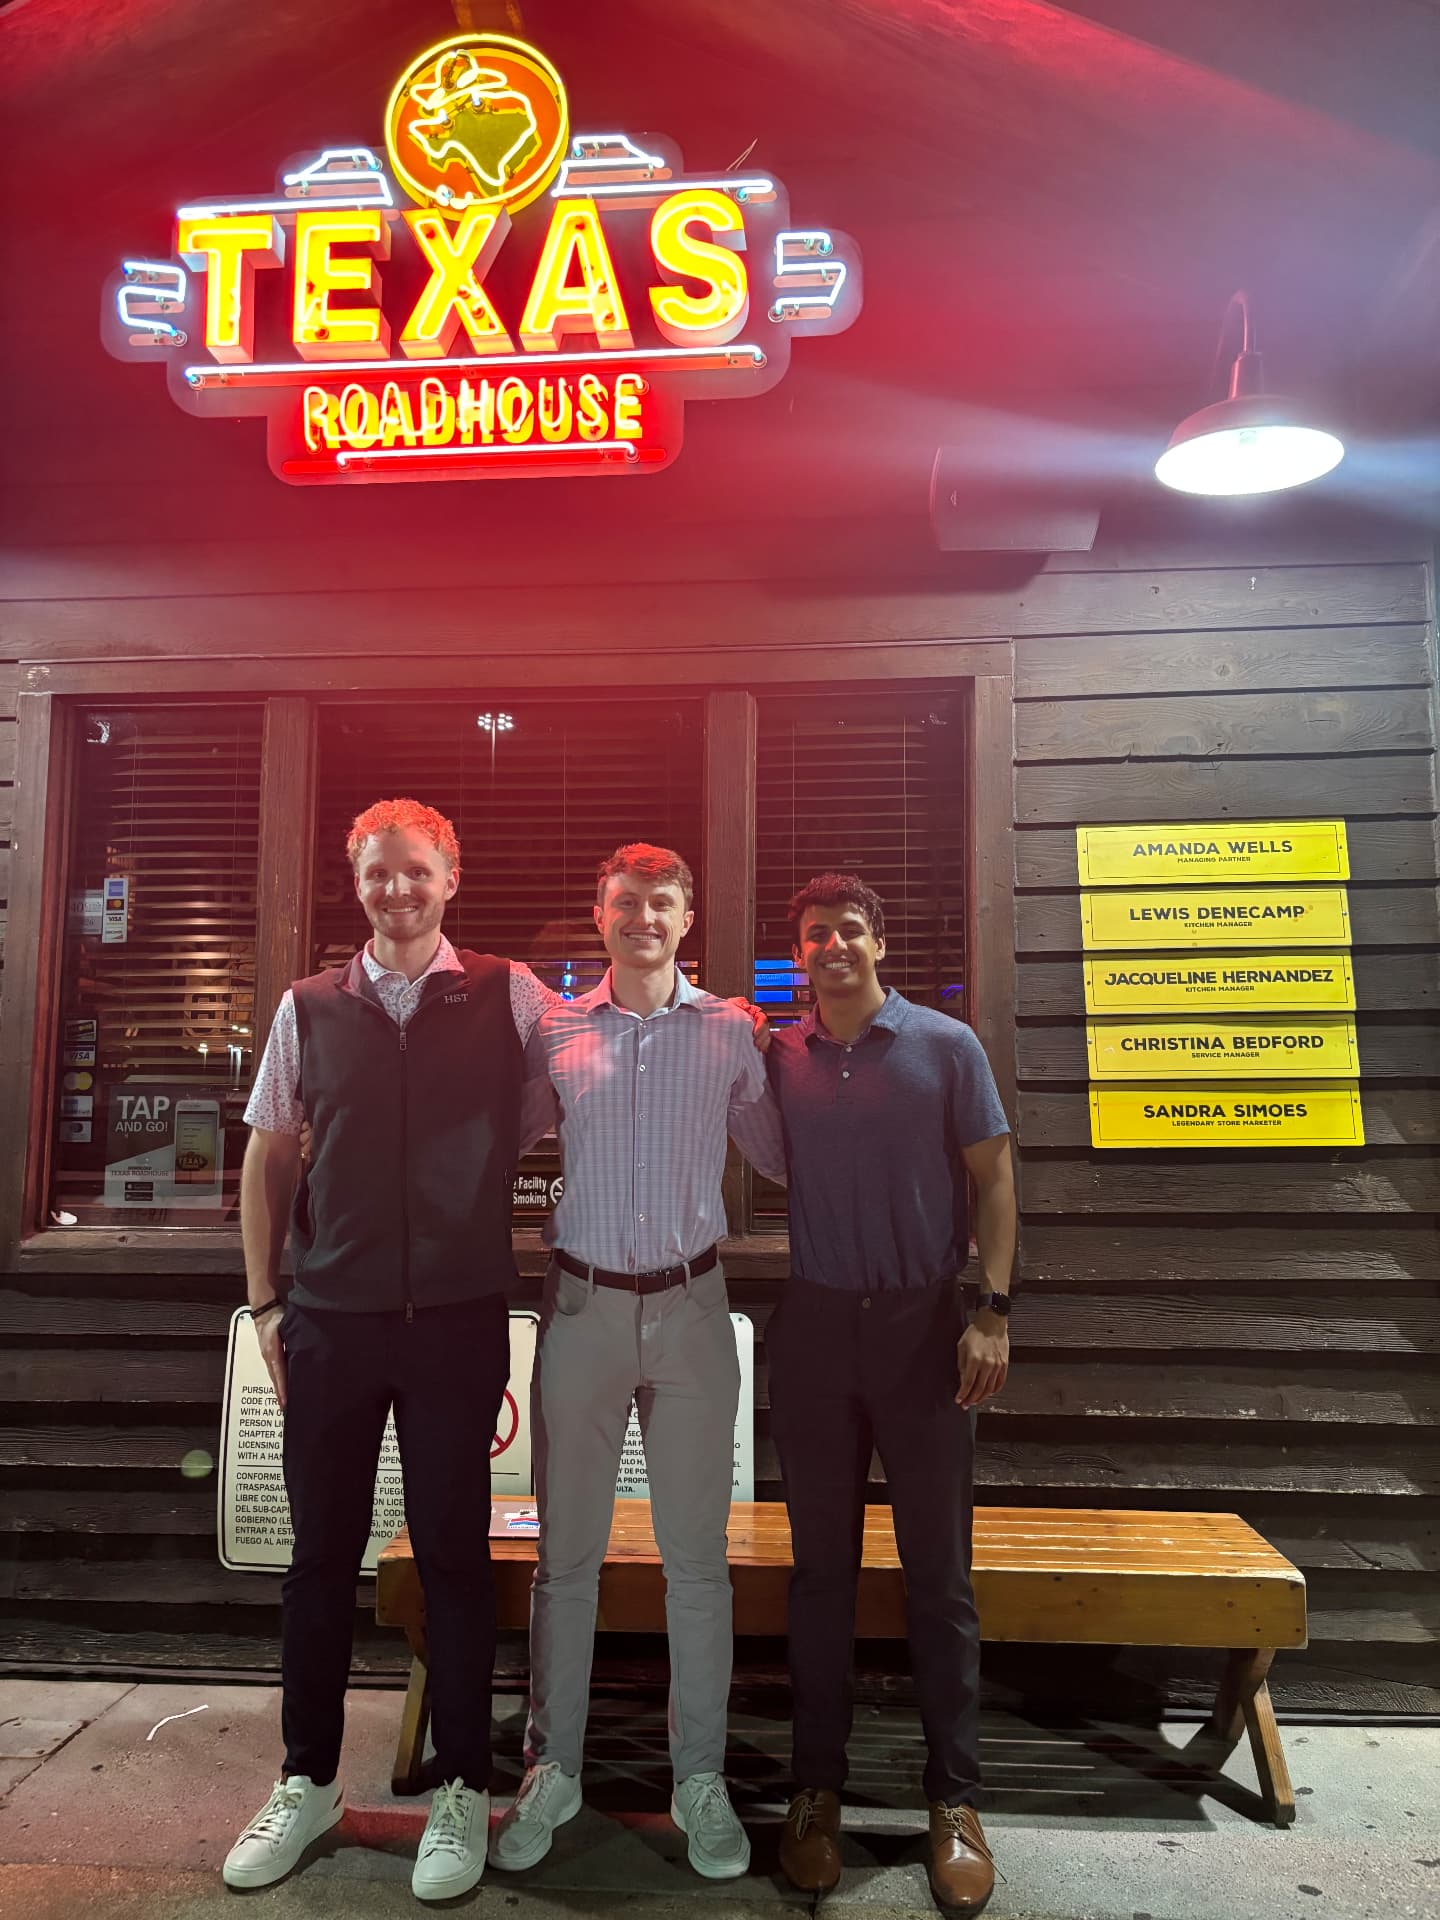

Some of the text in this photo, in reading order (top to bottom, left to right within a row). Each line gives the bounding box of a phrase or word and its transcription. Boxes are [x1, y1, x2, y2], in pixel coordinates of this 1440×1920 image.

[177, 189, 750, 360] TEXAS
[303, 374, 648, 452] ROADHOUSE
[1133, 840, 1293, 857] AMANDA WELLS
[1218, 855, 1251, 863] PARTNER
[1129, 905, 1305, 921] LEWIS DENECAMP
[1104, 969, 1334, 986] JACQUELINE HERNANDEZ
[1120, 1035, 1324, 1051] CHRISTINA BEDFORD
[116, 1095, 171, 1120] TAP
[1143, 1103, 1308, 1118] SANDRA SIMOES
[115, 1121, 168, 1132] AND GO!
[518, 1176, 547, 1192] Facility
[512, 1192, 547, 1207] Smoking
[242, 1386, 276, 1394] PURSUA
[241, 1397, 263, 1405] CODE
[240, 1408, 260, 1416] WITH
[240, 1419, 272, 1427] PERSON
[239, 1430, 275, 1438] CHAPTER
[238, 1441, 280, 1449] LICENSING
[238, 1452, 258, 1460] WITH
[260, 1452, 266, 1460] A
[380, 1456, 401, 1464] OPEN
[236, 1472, 281, 1480] CONFORME
[235, 1494, 259, 1502] LIBRE
[235, 1505, 251, 1513] DEL
[253, 1506, 290, 1514] SUB-CAPI
[235, 1516, 277, 1524] GOBIERNO
[235, 1526, 267, 1534] ENTRAR
